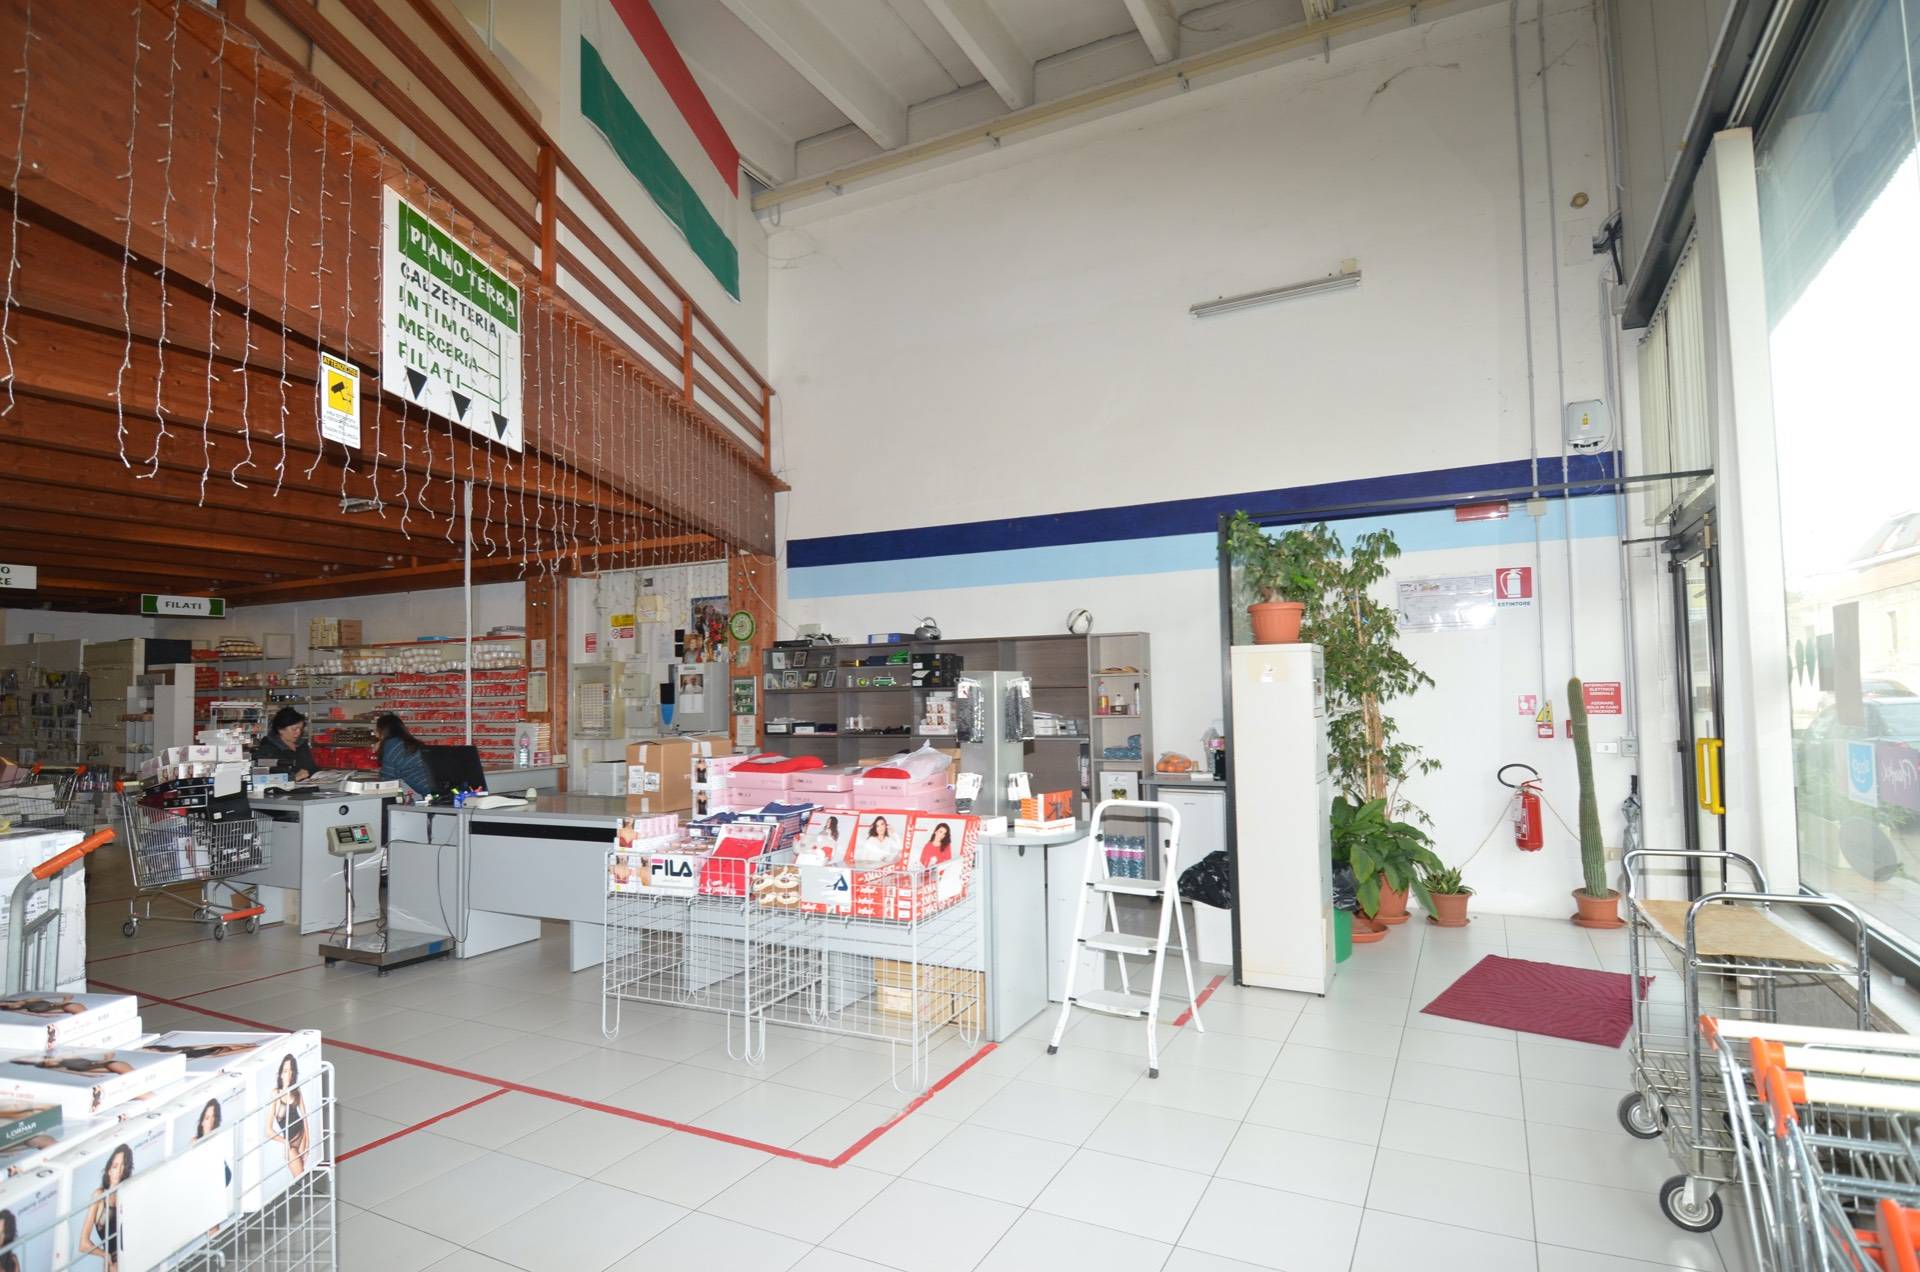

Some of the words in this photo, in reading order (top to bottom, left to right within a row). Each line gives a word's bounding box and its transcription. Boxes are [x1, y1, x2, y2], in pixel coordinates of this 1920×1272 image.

[410, 225, 464, 277] PIANO
[467, 269, 516, 318] TERRA
[399, 285, 471, 343] INTIMO
[400, 261, 497, 338] CALZETTERIA
[398, 312, 479, 370] MERCERIA
[398, 341, 461, 389] FILATI
[164, 600, 203, 611] FILATI
[651, 858, 693, 877] FILA
[6, 1122, 37, 1139] LORMAR
